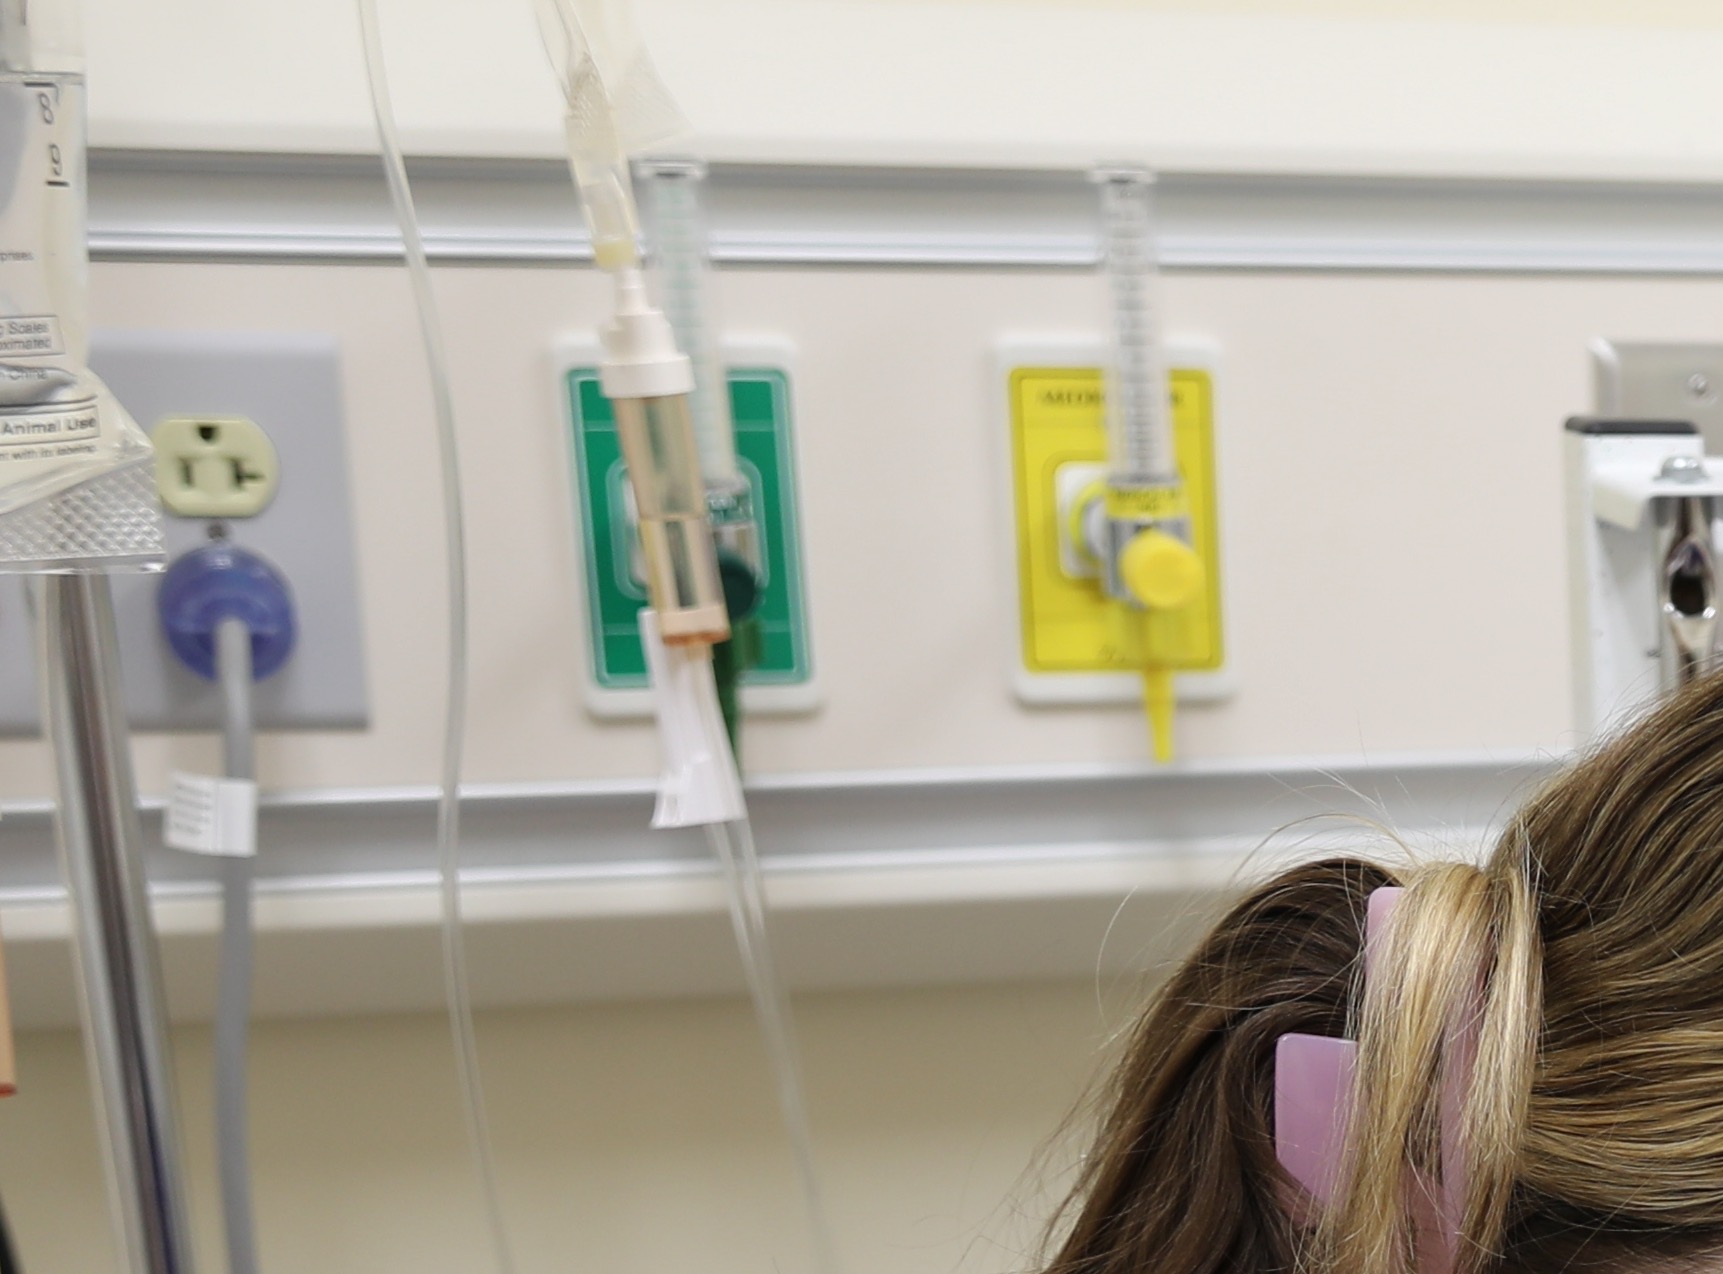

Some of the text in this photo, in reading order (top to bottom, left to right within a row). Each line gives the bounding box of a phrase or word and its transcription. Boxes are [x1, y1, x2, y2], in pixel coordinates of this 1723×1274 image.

[38, 91, 55, 125] 8
[9, 321, 49, 335] Scales
[3, 416, 97, 436] Animal Use
